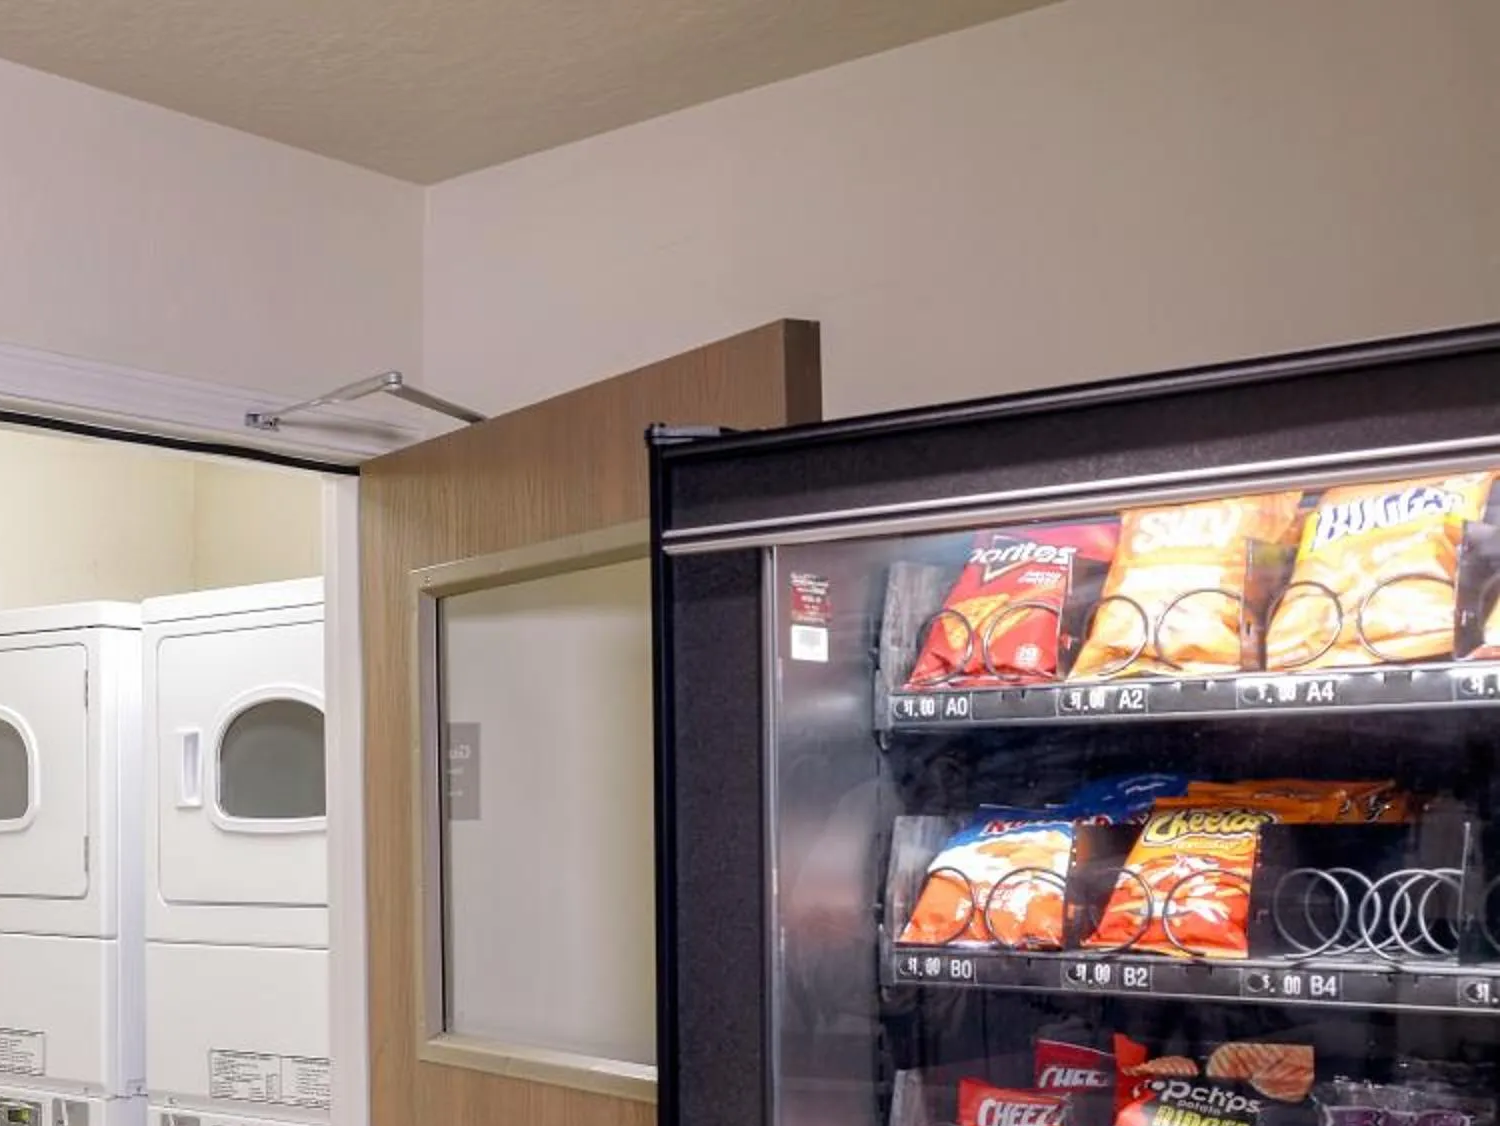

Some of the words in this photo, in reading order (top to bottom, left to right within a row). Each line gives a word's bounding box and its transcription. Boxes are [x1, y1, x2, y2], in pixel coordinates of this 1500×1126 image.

[1118, 688, 1144, 710] A2
[1306, 681, 1335, 702] A4
[945, 697, 969, 717] A0
[950, 960, 973, 979] B0
[1123, 966, 1148, 987] B2
[1310, 974, 1337, 997] B4
